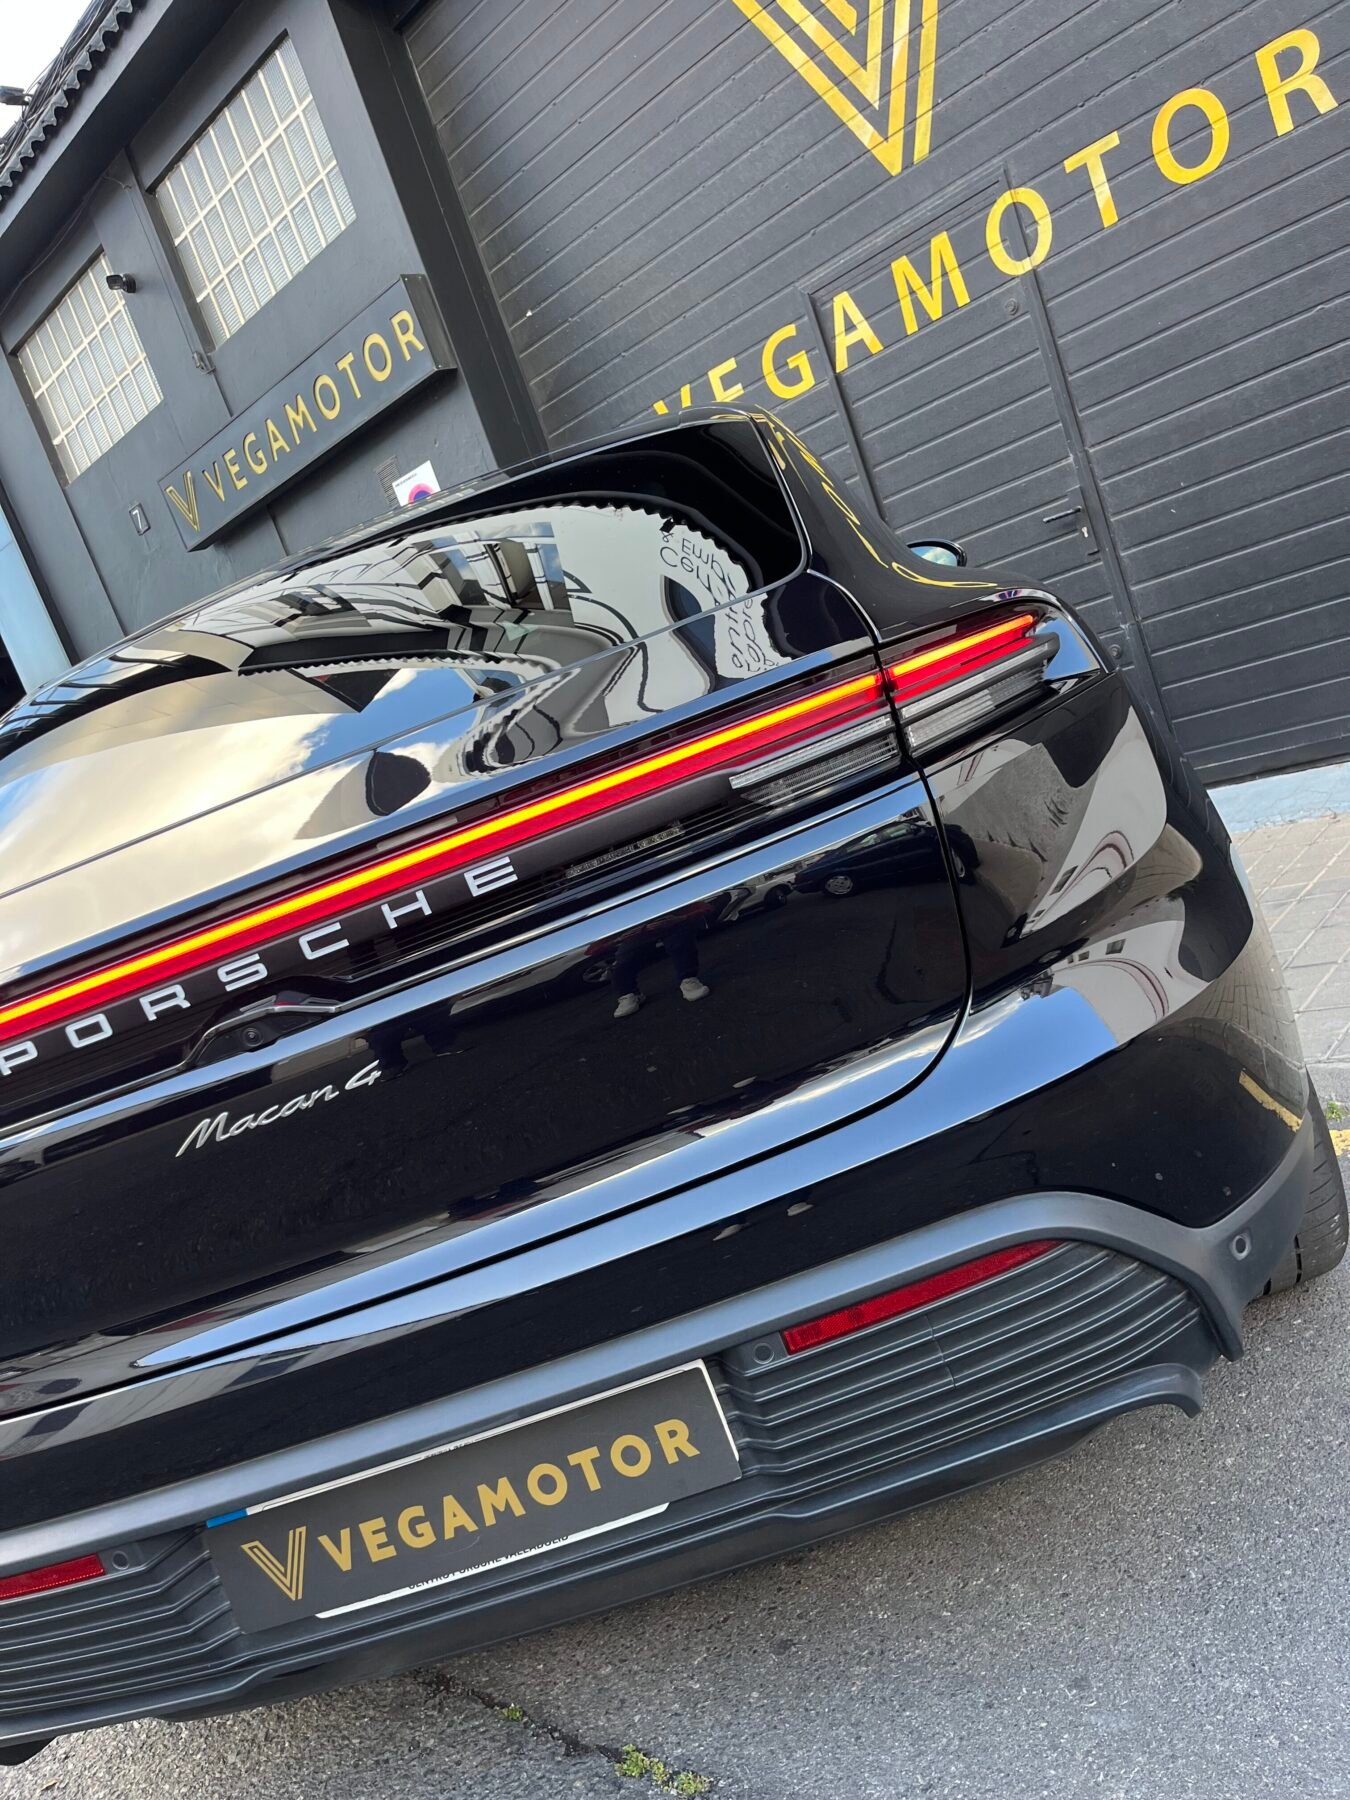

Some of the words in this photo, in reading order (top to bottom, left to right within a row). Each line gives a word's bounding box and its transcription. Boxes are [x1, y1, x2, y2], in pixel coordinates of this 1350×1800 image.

[652, 28, 1339, 415] EGAMOTOR
[202, 309, 426, 502] VEGAMOTOR
[0, 856, 519, 1076] PORSCHE
[175, 1086, 339, 1158] Macan
[345, 1059, 382, 1087] 4
[318, 1418, 701, 1572] VEGAMOTOR
